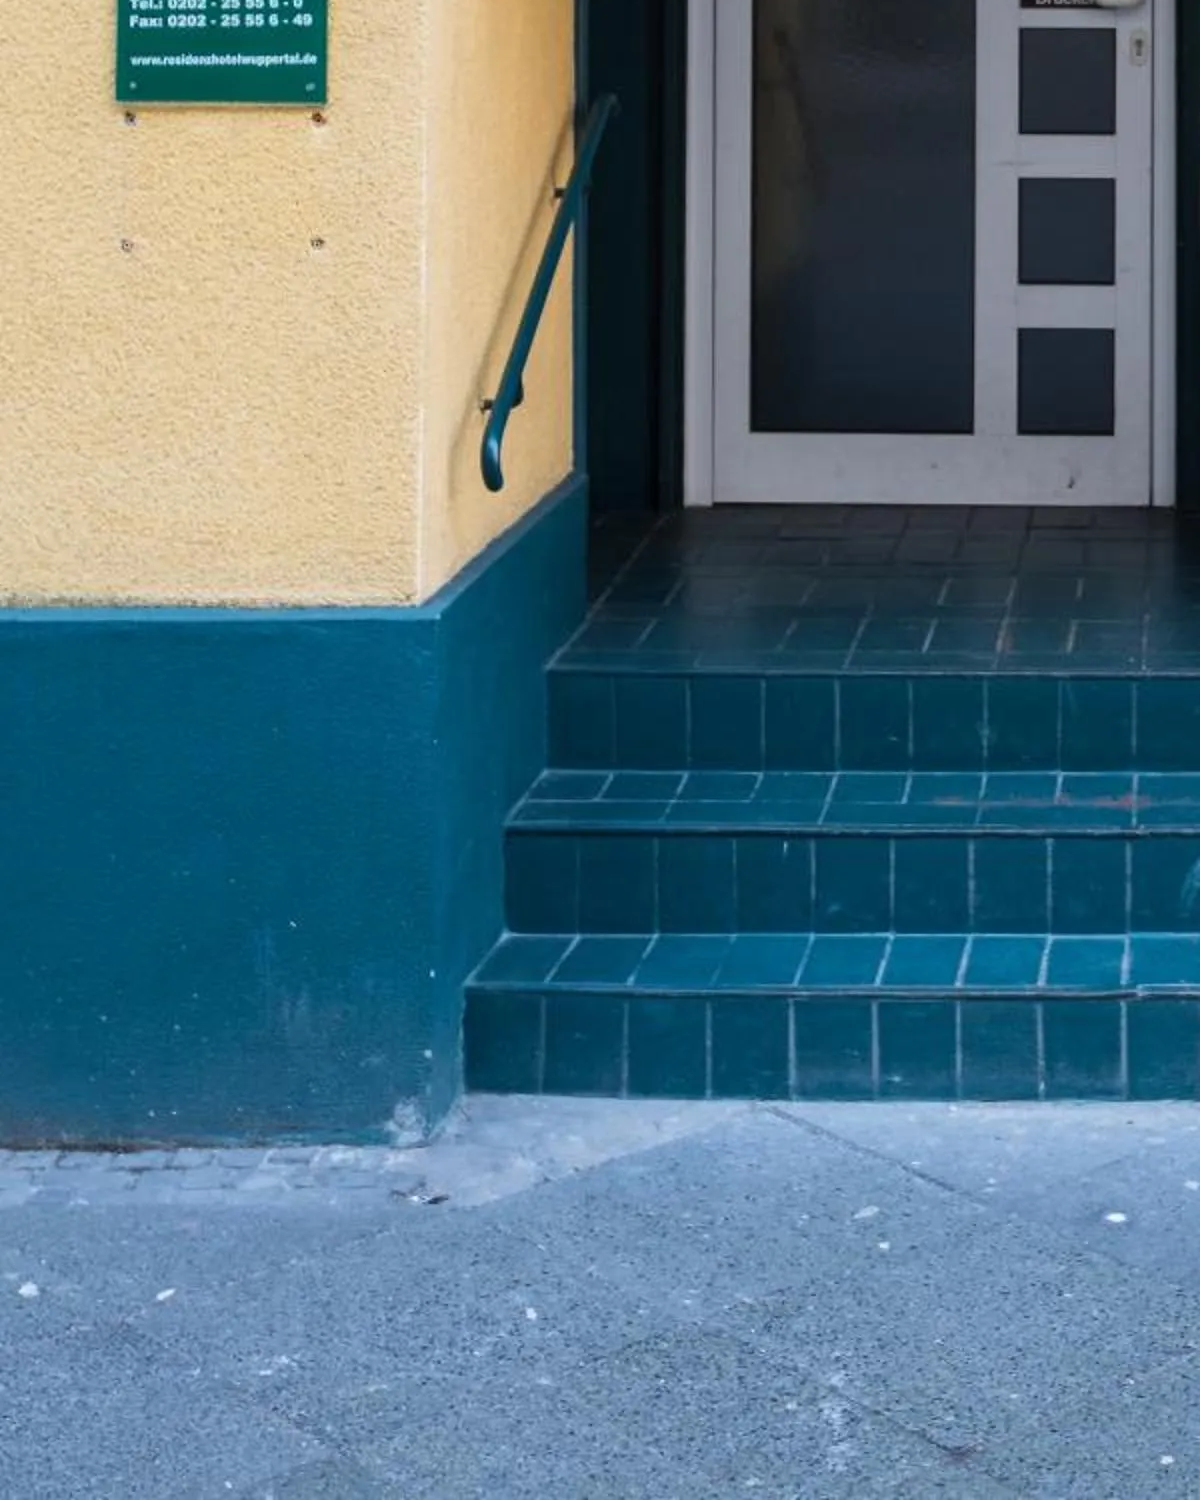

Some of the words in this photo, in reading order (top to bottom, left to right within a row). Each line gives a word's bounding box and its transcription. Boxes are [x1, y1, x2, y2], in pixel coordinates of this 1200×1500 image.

[129, 15, 163, 28] Fax:
[167, 14, 207, 28] 0202
[220, 14, 240, 27] 25
[245, 14, 264, 27] 55
[292, 14, 313, 27] 49
[130, 52, 318, 67] www.residenzhotelwuppertal.de
